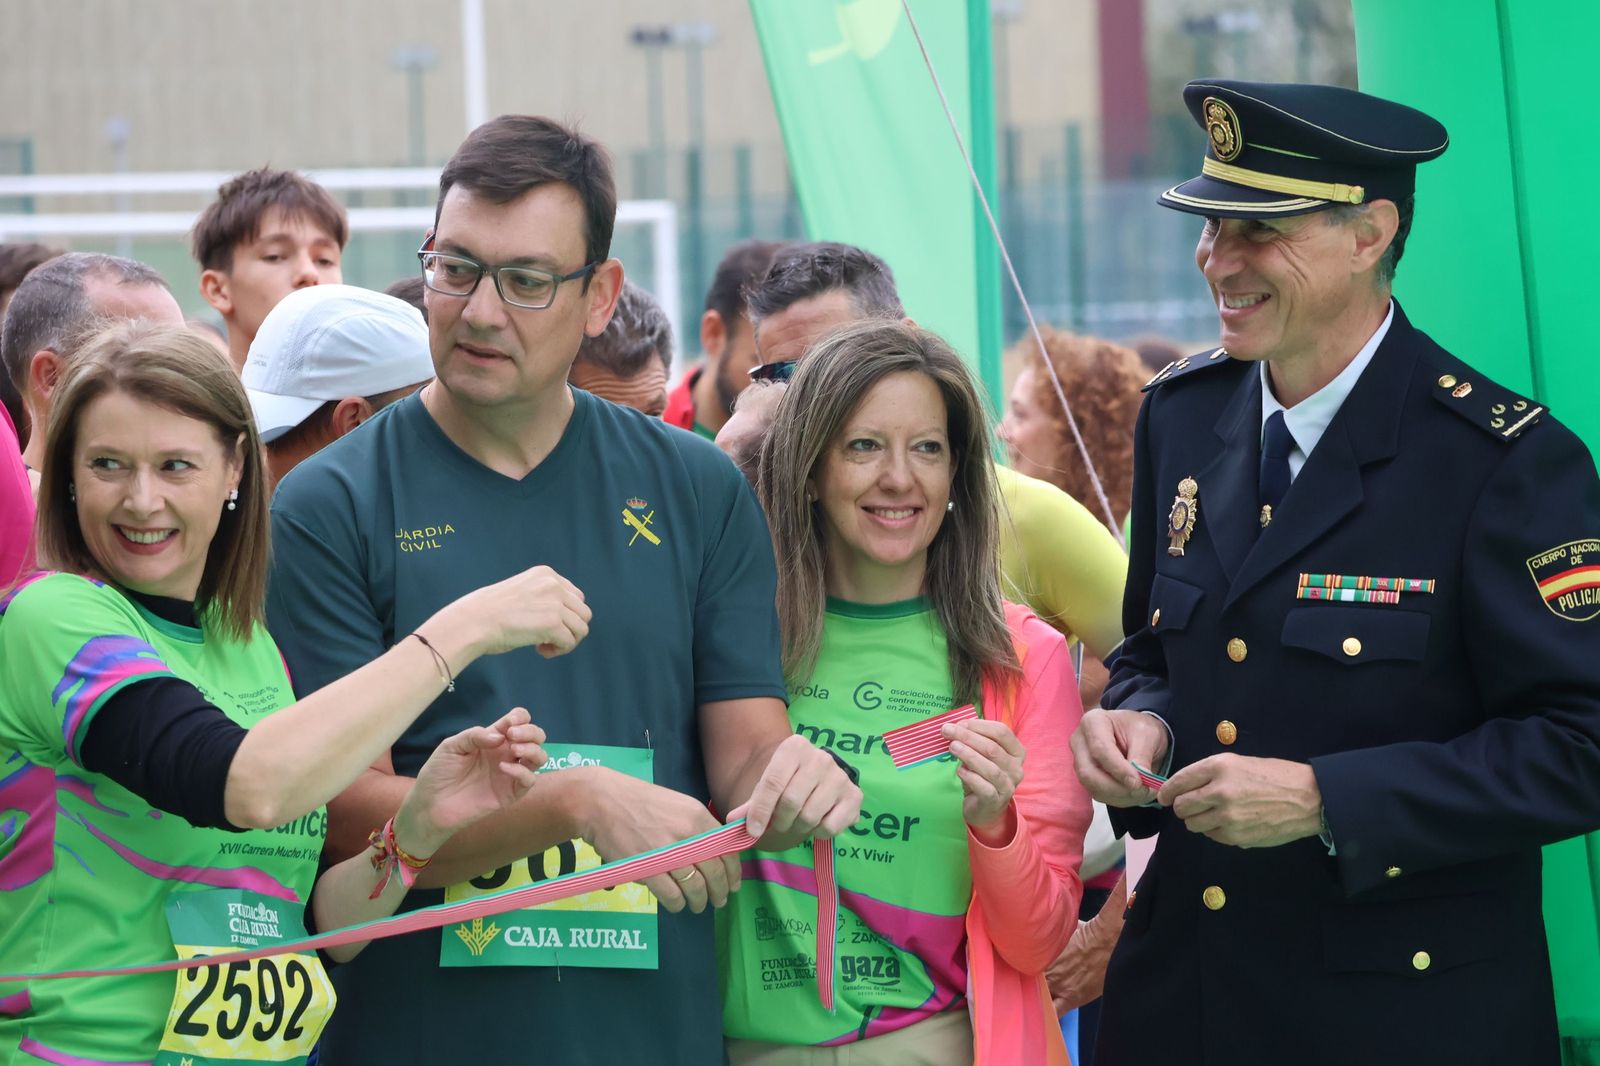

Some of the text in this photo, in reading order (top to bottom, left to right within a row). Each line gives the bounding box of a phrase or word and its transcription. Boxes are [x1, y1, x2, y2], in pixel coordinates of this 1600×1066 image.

[400, 538, 442, 552] CIVIL
[1531, 548, 1567, 569] CUERPO
[1570, 555, 1583, 565] DE
[793, 684, 830, 700] rola
[888, 696, 916, 705] contra
[898, 704, 931, 715] Zamora
[219, 842, 241, 855] XVII
[242, 843, 275, 857] Carrera
[274, 845, 301, 859] Mucho
[299, 848, 310, 860] X
[850, 846, 861, 859] X
[863, 848, 895, 864] Vivir
[503, 925, 648, 950] CAJA RURAL
[762, 969, 792, 983] CAJA
[840, 955, 901, 983] gaza
[173, 954, 313, 1042] 2592
